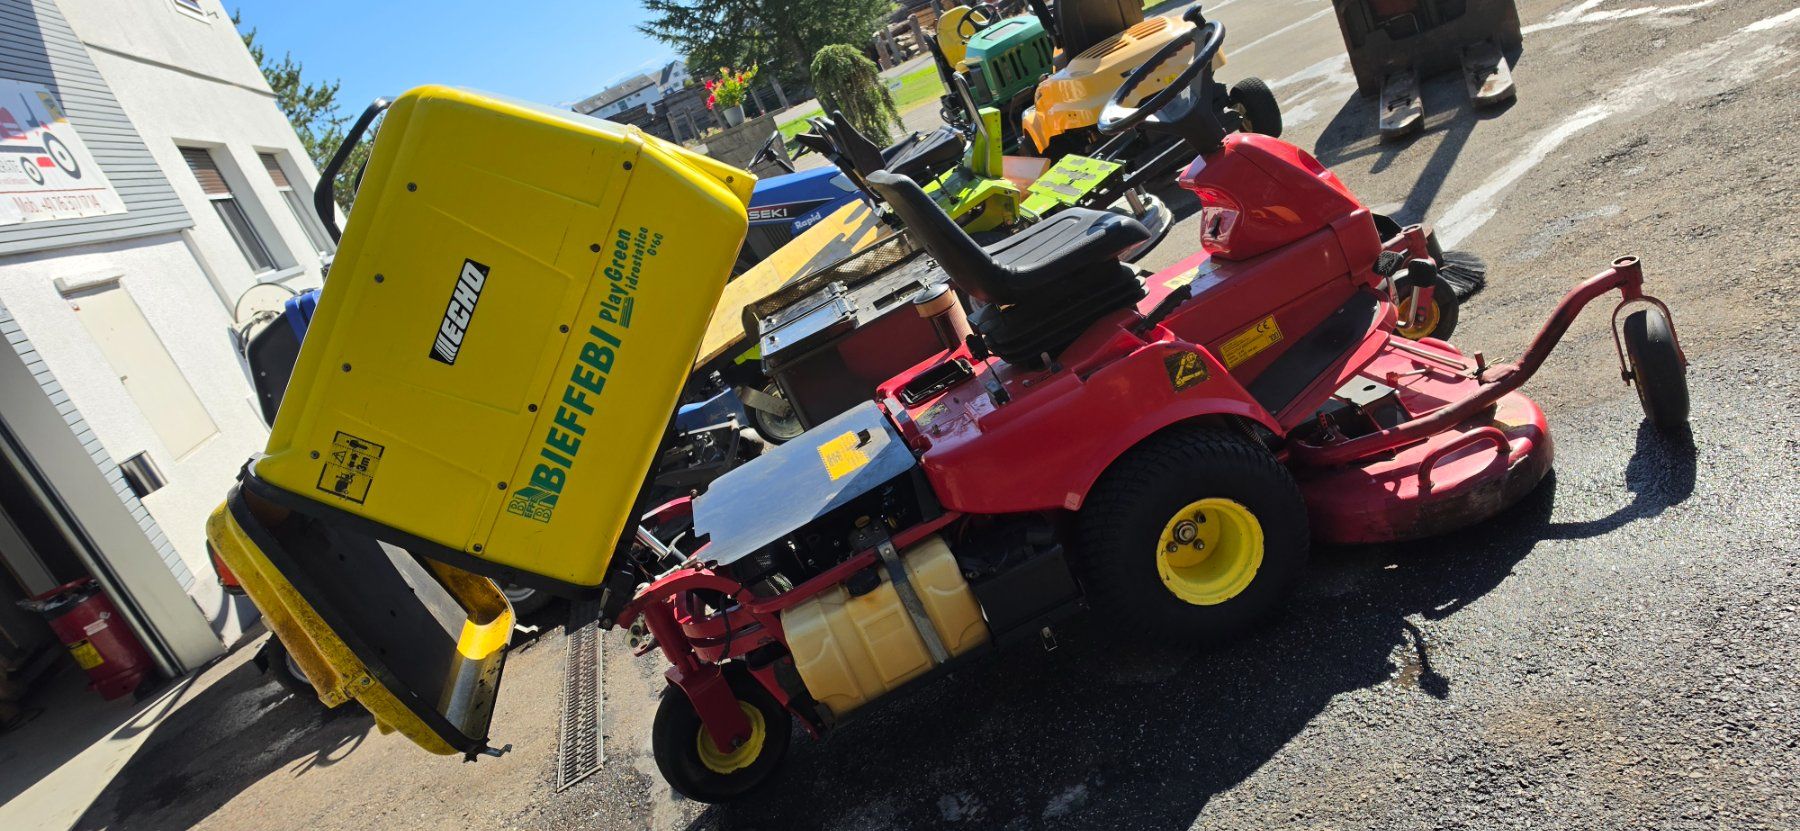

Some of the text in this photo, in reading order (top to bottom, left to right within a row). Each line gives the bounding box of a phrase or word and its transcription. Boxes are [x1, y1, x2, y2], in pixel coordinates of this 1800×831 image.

[748, 208, 787, 219] SEKI
[794, 212, 822, 230] Rapid
[625, 226, 648, 290] idrostatico
[441, 262, 485, 345] ECHO
[529, 325, 622, 495] BIEFFEBI
[356, 457, 370, 471] 3m
